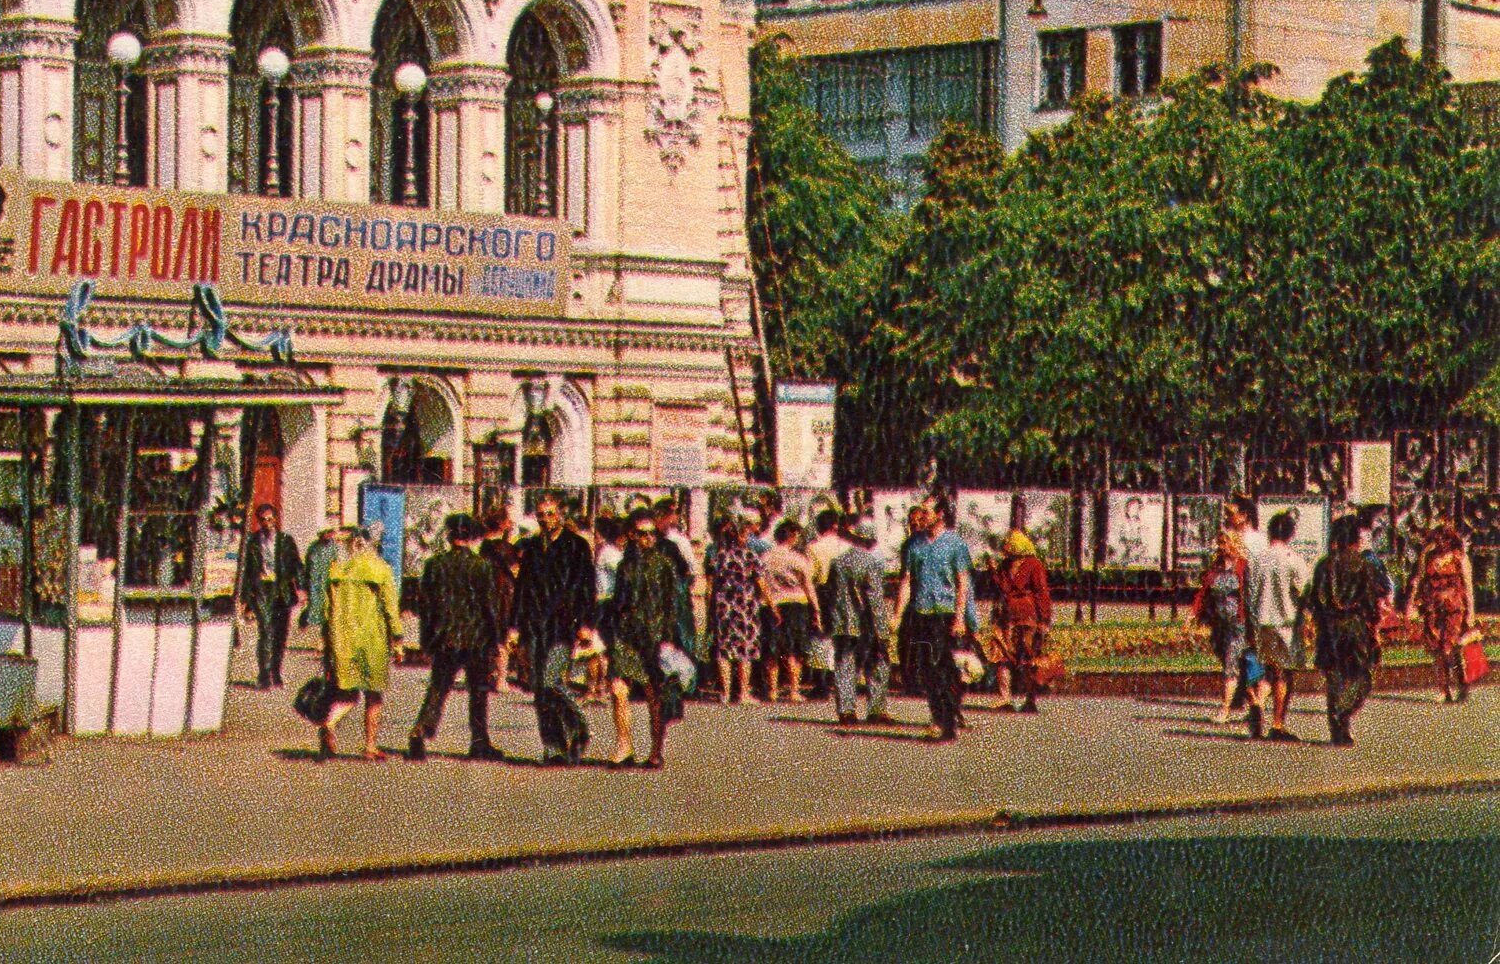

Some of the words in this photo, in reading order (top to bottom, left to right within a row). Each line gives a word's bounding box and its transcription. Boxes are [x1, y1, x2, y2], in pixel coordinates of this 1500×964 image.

[29, 196, 221, 282] ГАСТРОЛИ
[240, 210, 556, 262] КРАСНОЯРСКОГО
[236, 251, 351, 289] ТЕАТРА
[365, 259, 464, 295] ДРАМЫ
